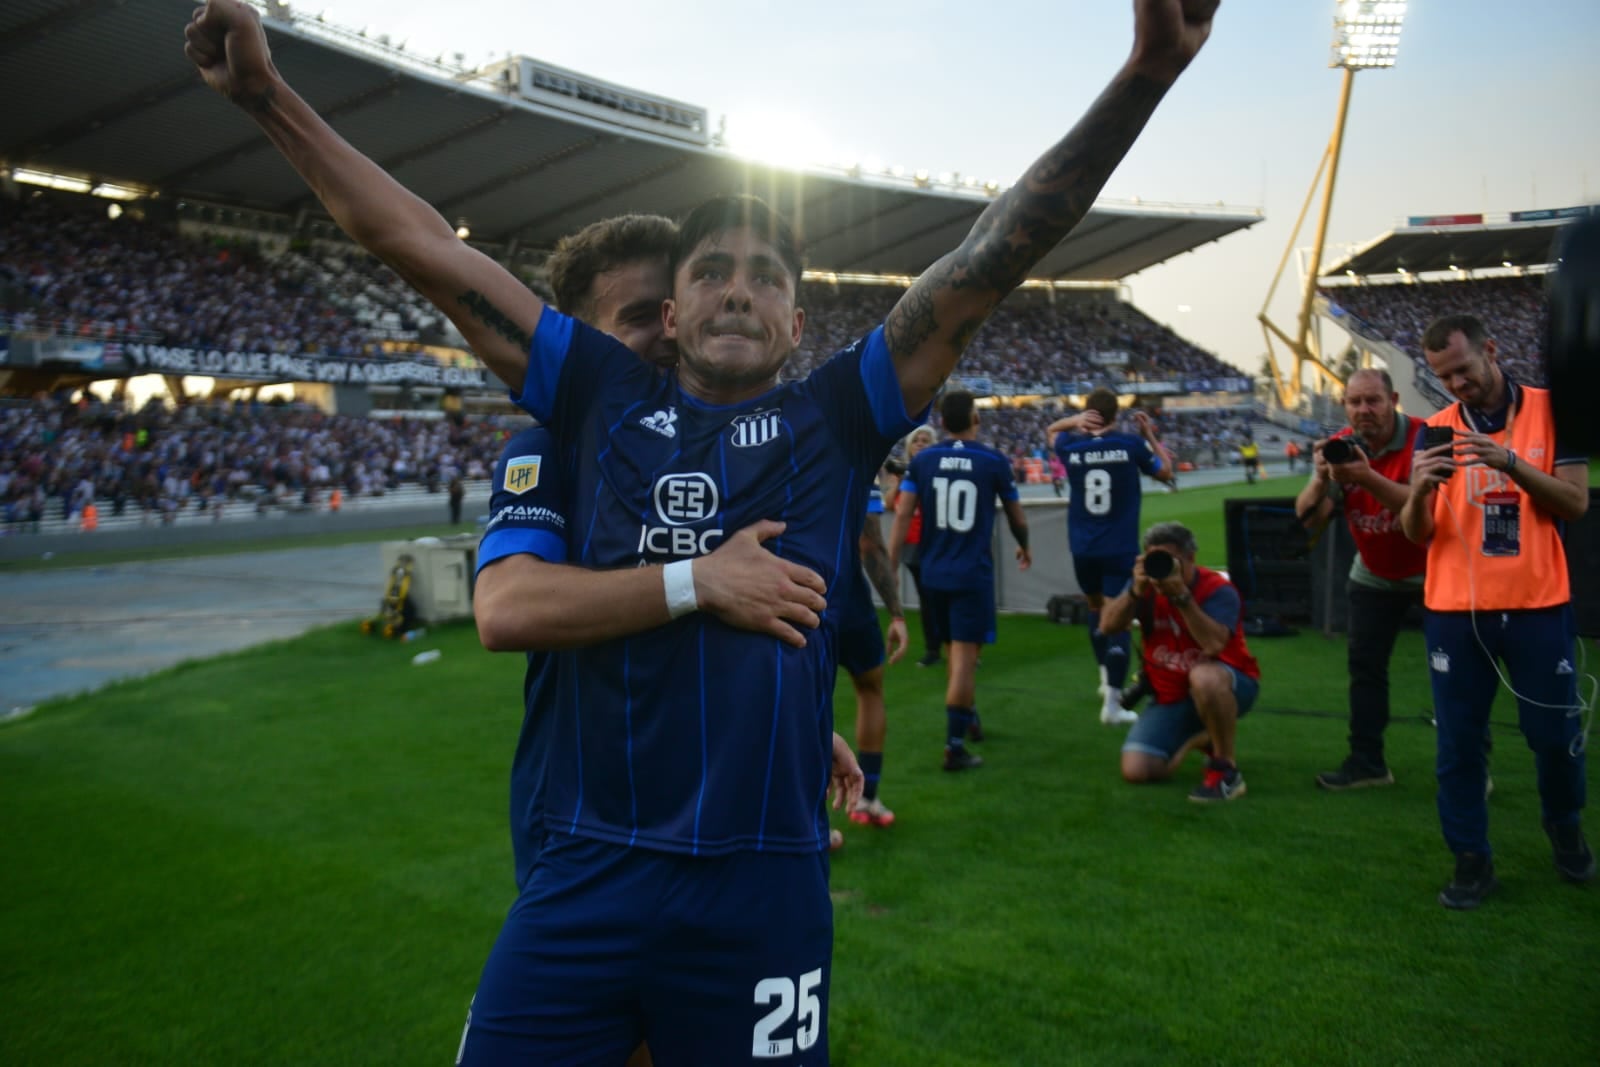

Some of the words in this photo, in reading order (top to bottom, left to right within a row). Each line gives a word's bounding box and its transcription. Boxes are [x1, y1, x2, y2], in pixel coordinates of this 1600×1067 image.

[198, 350, 224, 371] LO
[225, 351, 268, 374] QUE
[316, 361, 347, 381] VOY
[349, 363, 362, 382] A
[510, 467, 533, 488] LPF
[1085, 469, 1111, 514] 8
[933, 477, 977, 532] 10
[637, 524, 724, 556] ICBC
[751, 968, 822, 1058] 25
